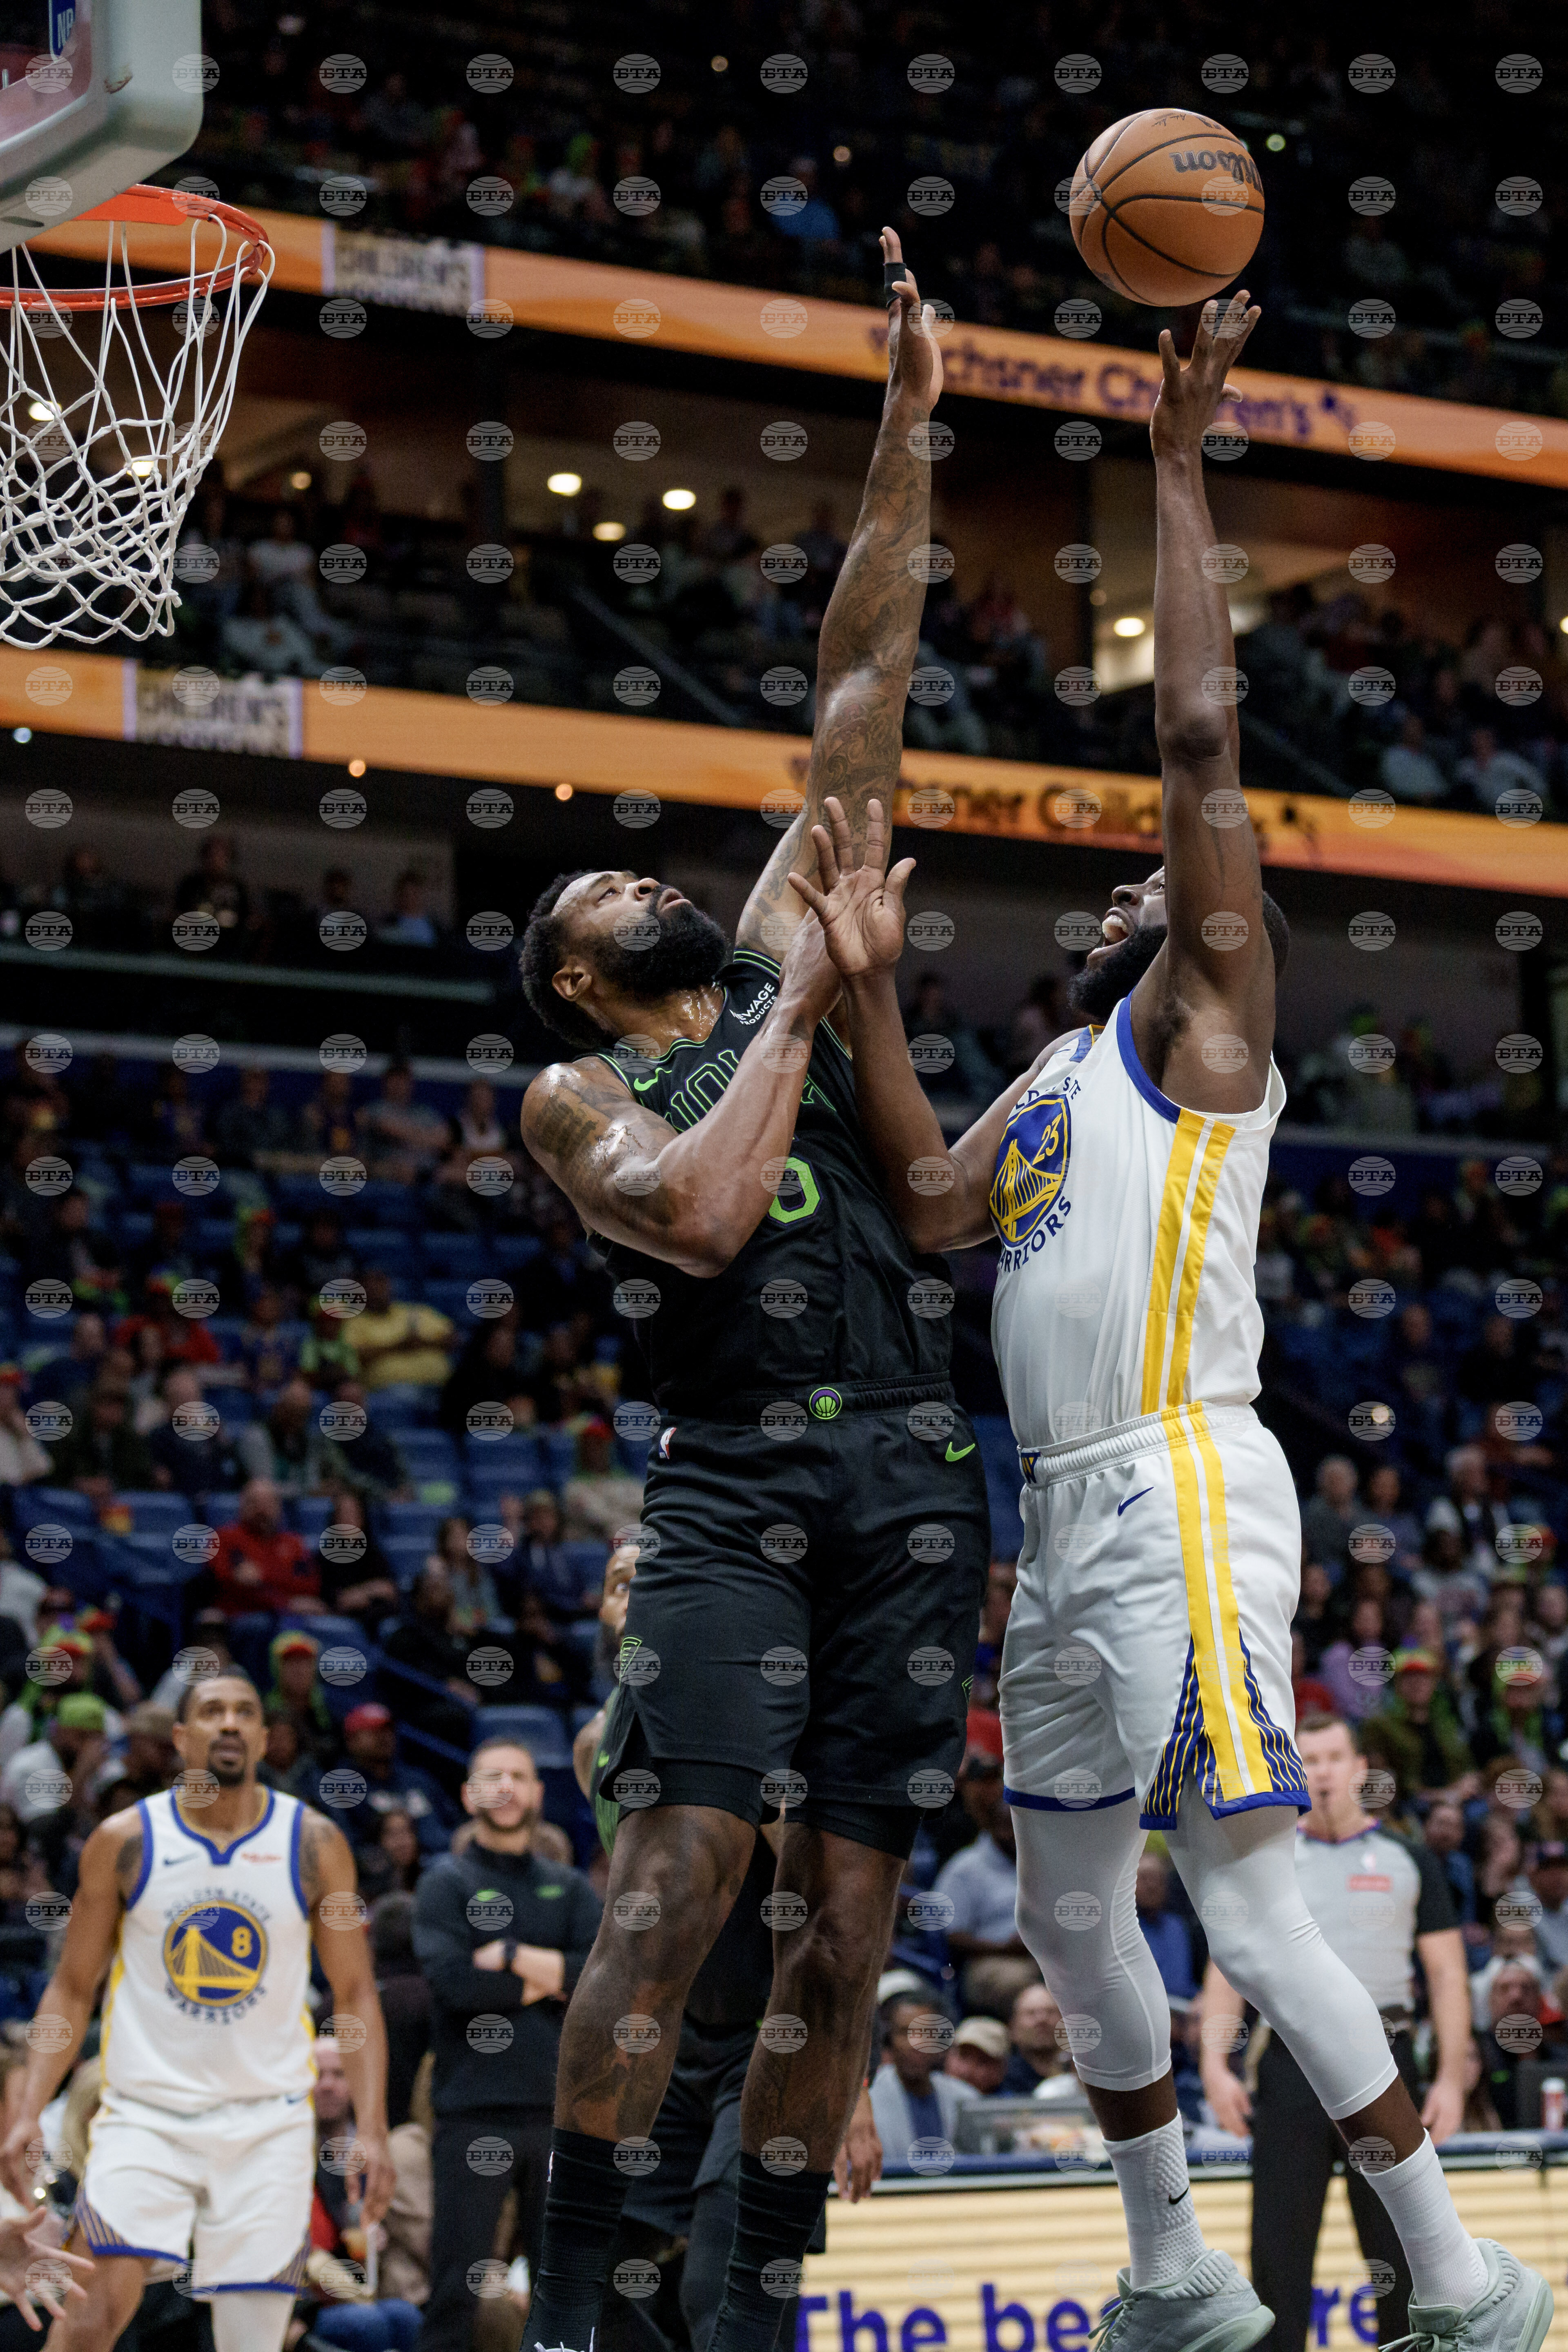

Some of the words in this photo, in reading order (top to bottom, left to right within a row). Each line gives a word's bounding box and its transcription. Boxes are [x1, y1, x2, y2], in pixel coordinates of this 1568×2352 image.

[739, 995, 777, 1025] PRODUCTS
[1032, 1113, 1062, 1165] 23
[999, 1196, 1071, 1273] ARRIORS
[231, 1925, 252, 1959] 8
[1311, 2283, 1379, 2346] re
